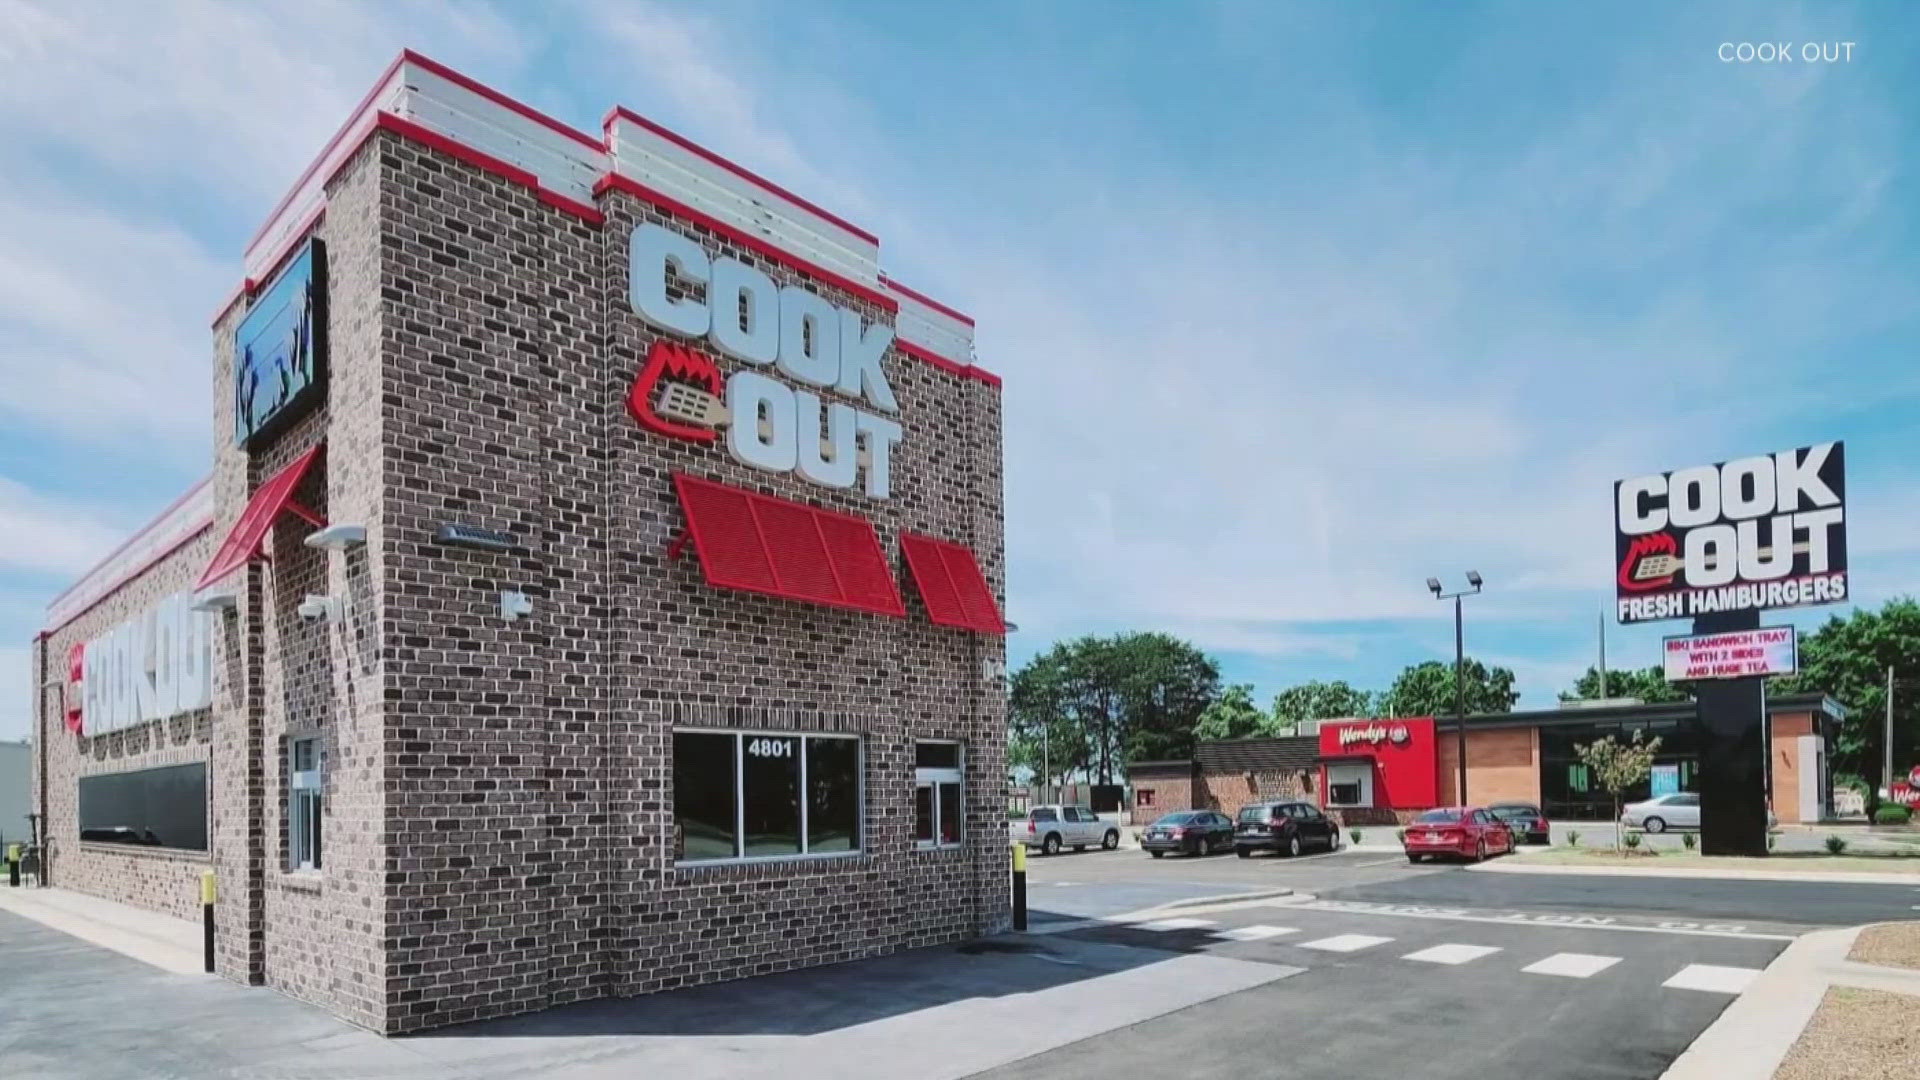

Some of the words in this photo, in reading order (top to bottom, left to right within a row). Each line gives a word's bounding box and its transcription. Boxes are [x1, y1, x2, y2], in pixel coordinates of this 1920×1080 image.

[629, 221, 899, 413] COOK
[725, 369, 902, 500] OUT
[1618, 441, 1842, 536] COOK
[1684, 506, 1843, 588] OUT
[1618, 595, 1684, 620] FRESH
[1689, 575, 1845, 613] HAMBURGERS
[1667, 641, 1689, 652] BBQ
[1693, 634, 1753, 649] SANDWICH
[1758, 632, 1787, 643] TRAY
[1690, 651, 1718, 663] WITH
[1721, 651, 1728, 660] 2
[82, 609, 157, 738] COOK
[1686, 666, 1709, 676] AND
[1747, 661, 1769, 672] TEA
[748, 738, 792, 758] 4801
[1339, 723, 1387, 745] Wendy's
